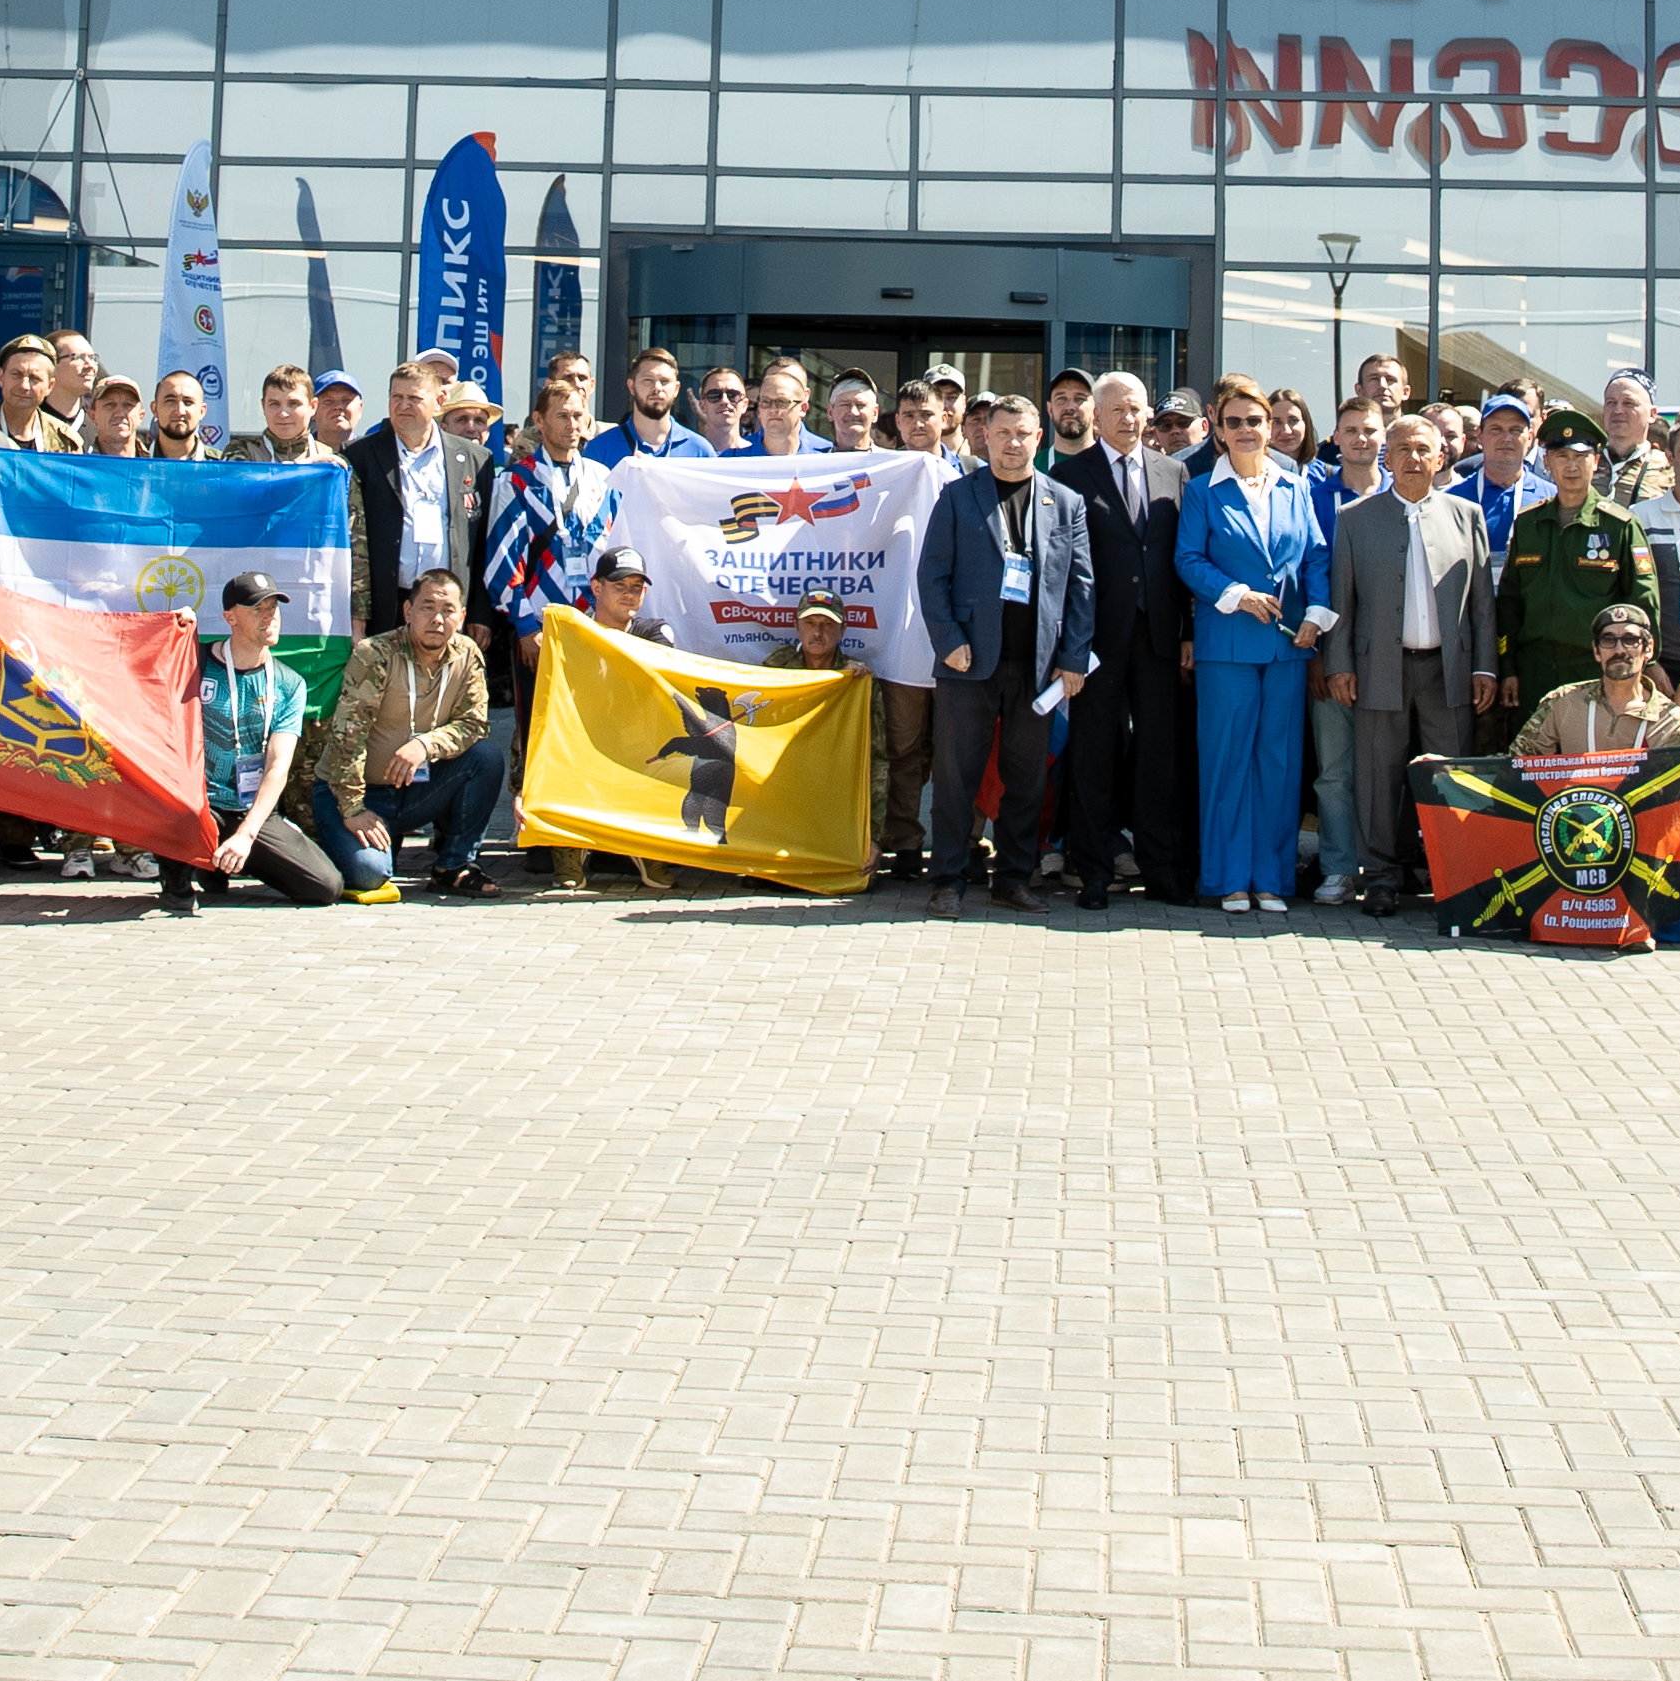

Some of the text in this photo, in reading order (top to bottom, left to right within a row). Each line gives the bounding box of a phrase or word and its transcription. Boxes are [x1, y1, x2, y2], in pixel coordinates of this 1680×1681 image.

[435, 198, 472, 352] ПИКС
[704, 549, 886, 572] ЗАЩИТНИКИ
[716, 574, 875, 595] ОТЕЧЕСТВА
[721, 605, 771, 623] СВОИХ
[1534, 755, 1585, 767] отдельная
[1600, 765, 1640, 778] бригада
[1618, 813, 1632, 849] нами
[1575, 869, 1607, 886] МСВ
[1561, 898, 1617, 912] в/ч 45863
